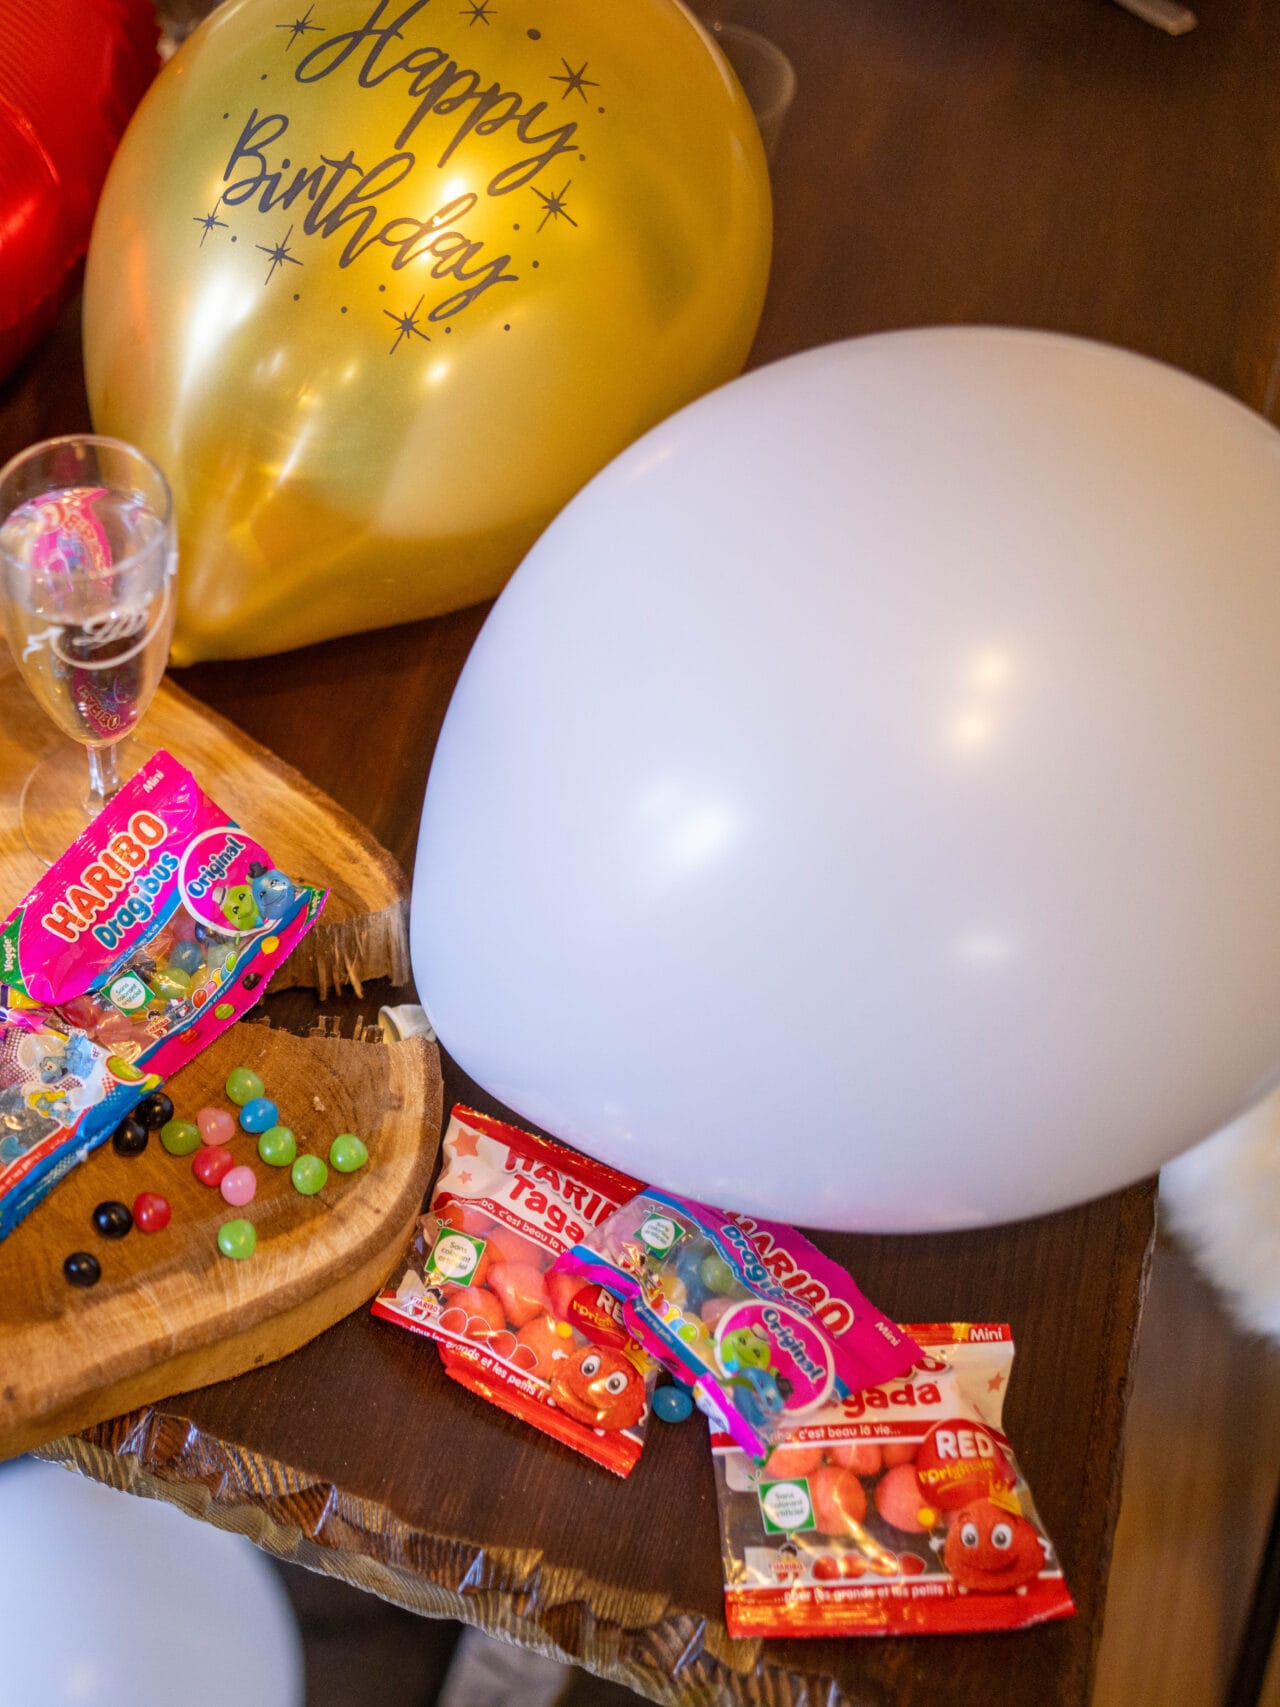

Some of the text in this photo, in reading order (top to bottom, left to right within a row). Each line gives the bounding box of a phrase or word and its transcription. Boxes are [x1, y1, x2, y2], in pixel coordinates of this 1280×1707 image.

[295, 0, 578, 197] Happy
[220, 107, 519, 323] Birthday
[143, 770, 165, 793] Mini
[42, 811, 167, 941] HARIBO
[187, 836, 245, 897] Original
[93, 853, 180, 949] Dragibus
[499, 1209, 521, 1228] c'est
[522, 1223, 548, 1243] beau
[549, 1238, 559, 1249] la
[762, 1307, 826, 1383] Original
[875, 1321, 901, 1348] Mini
[970, 1327, 1003, 1342] Mini
[481, 1356, 491, 1369] et
[492, 1362, 507, 1378] les
[842, 1382, 942, 1419] gada
[798, 1427, 825, 1440] c'est
[828, 1426, 858, 1439] beau
[935, 1429, 995, 1460] RED
[911, 1584, 944, 1598] petits
